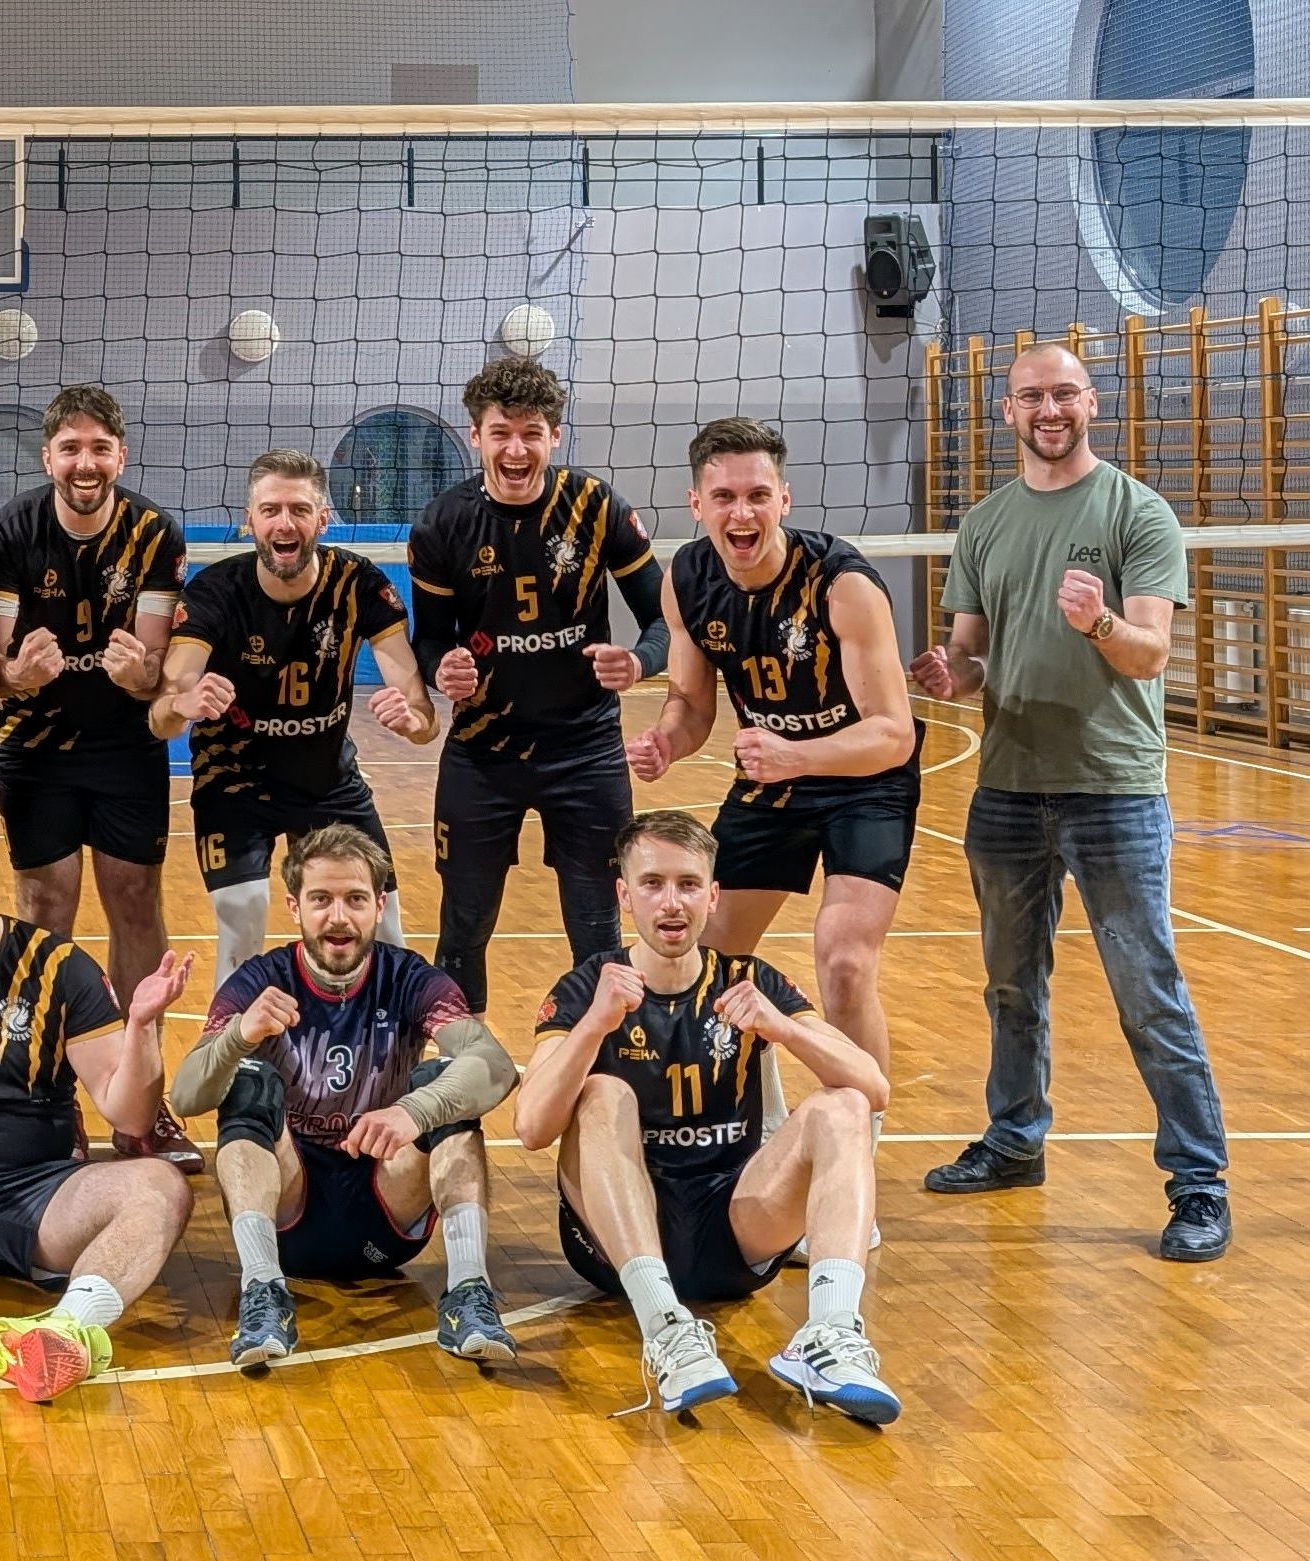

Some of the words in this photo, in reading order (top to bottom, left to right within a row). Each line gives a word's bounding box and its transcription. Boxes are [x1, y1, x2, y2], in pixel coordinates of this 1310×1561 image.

[1067, 543, 1101, 564] Lee
[470, 564, 505, 578] PEHA
[33, 586, 67, 599] PEHA
[516, 575, 539, 622] 5
[76, 599, 93, 643] 9
[497, 624, 587, 654] PROSTER
[700, 638, 737, 653] PEHA
[65, 650, 104, 672] ROS
[240, 651, 277, 665] PEHA
[278, 661, 310, 707] 16
[742, 655, 787, 701] 13
[254, 702, 348, 737] PROSTER
[744, 703, 848, 733] PROSTER
[199, 833, 227, 873] 16
[437, 820, 450, 860] 5
[326, 1045, 354, 1093] 3
[618, 1048, 660, 1060] PEHA
[666, 1063, 703, 1117] 11
